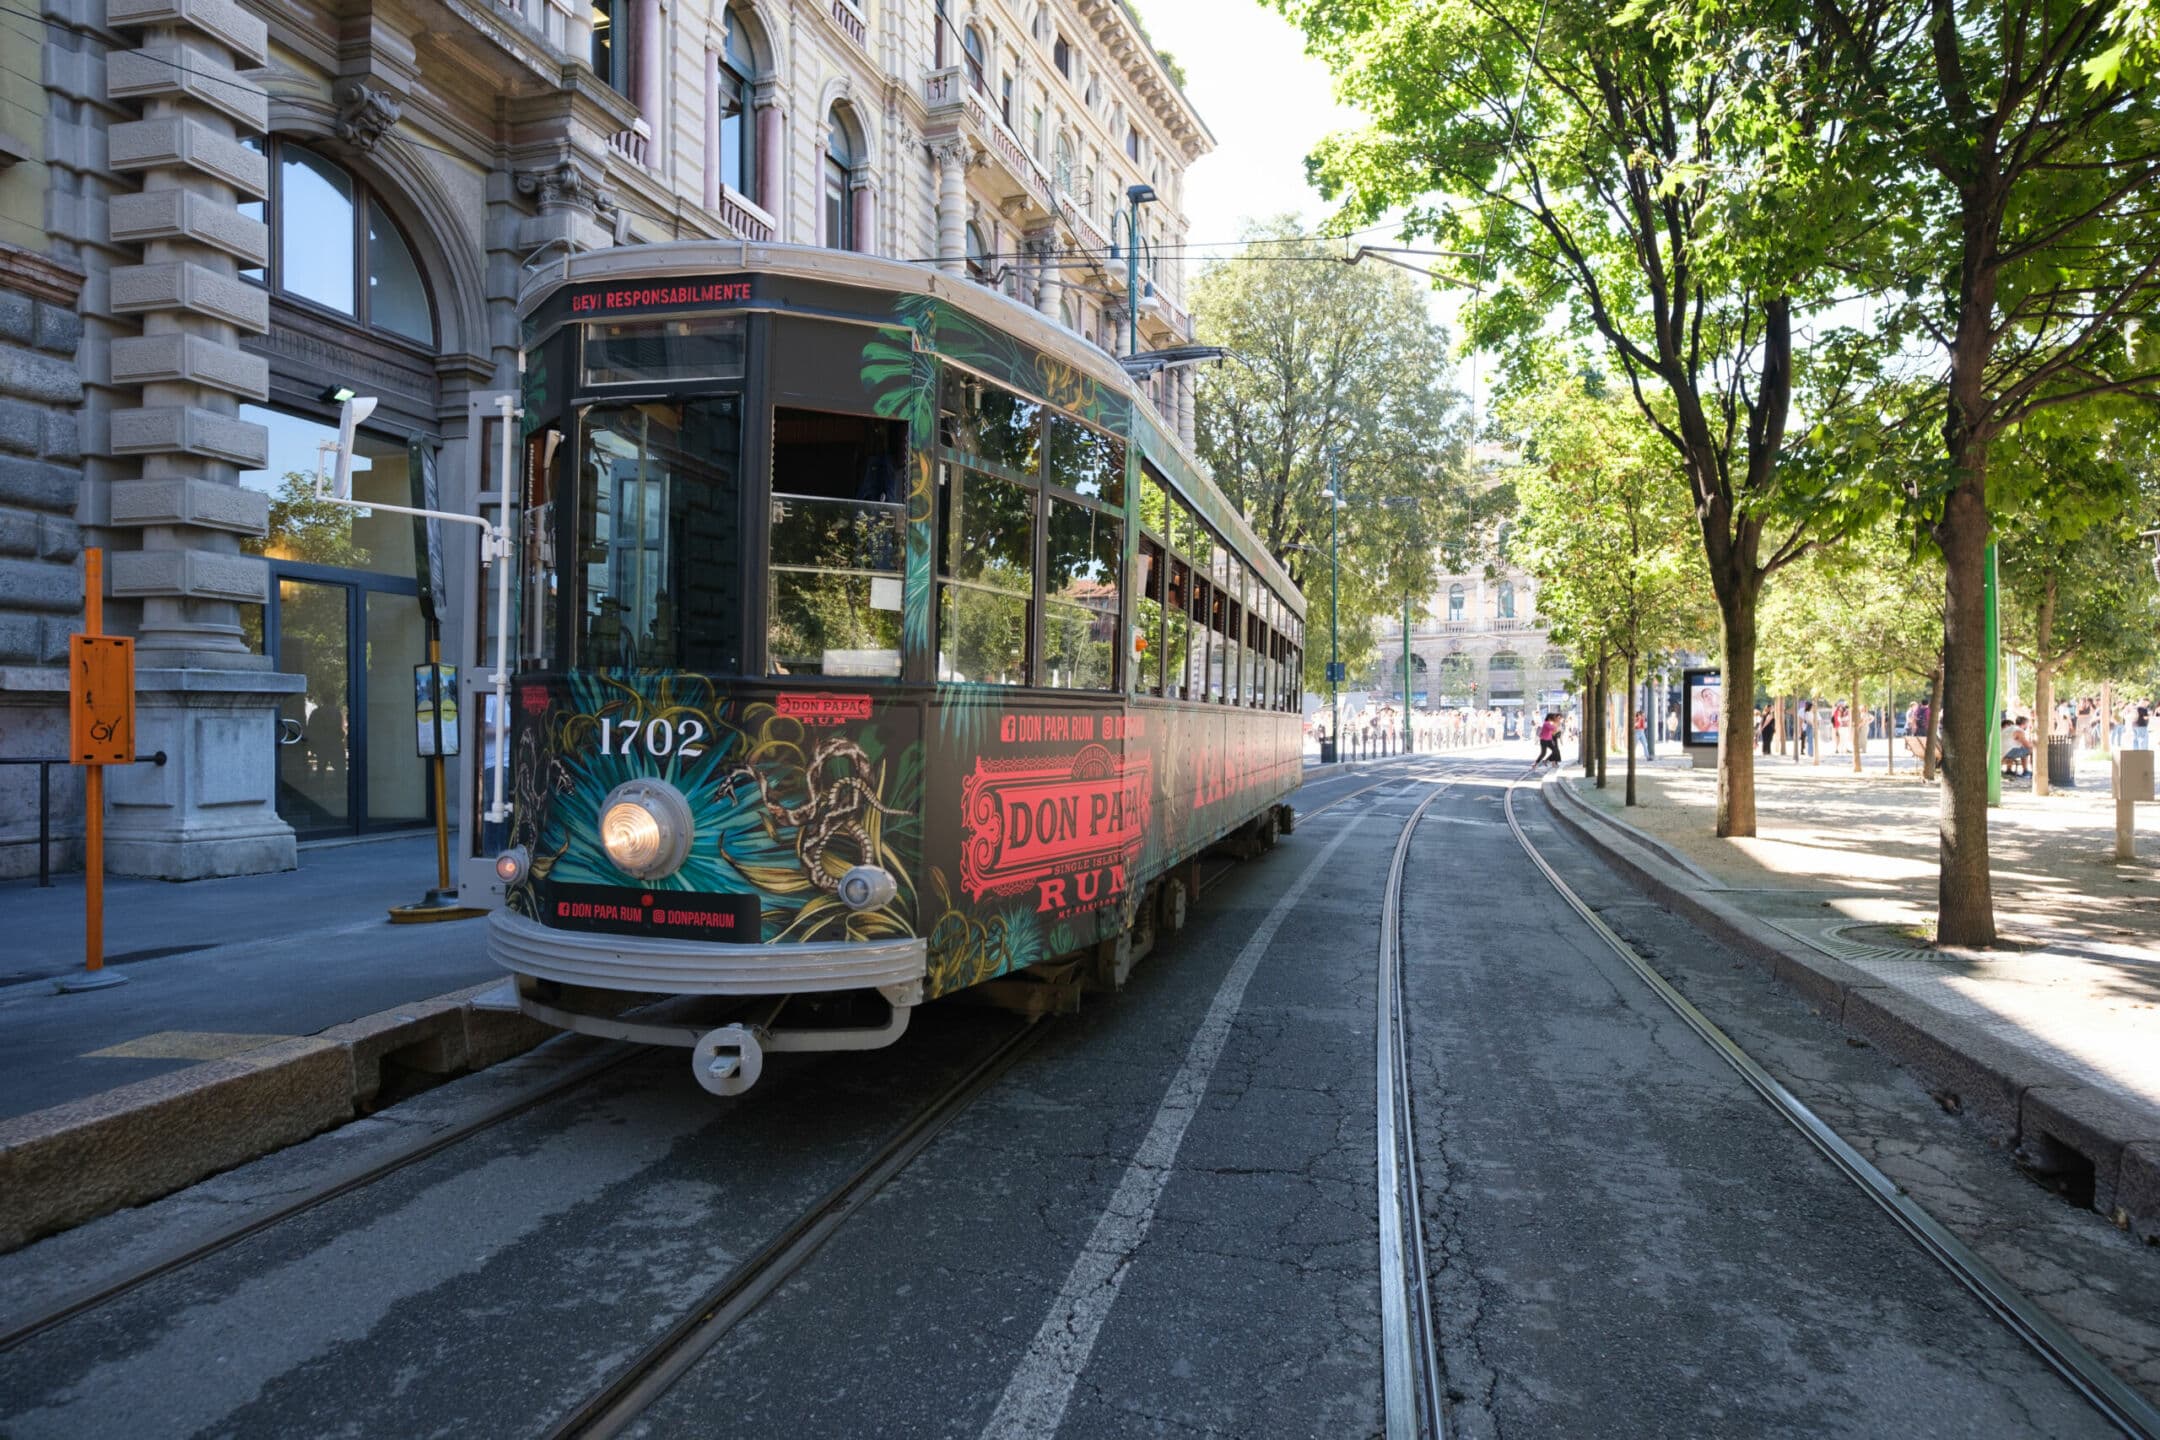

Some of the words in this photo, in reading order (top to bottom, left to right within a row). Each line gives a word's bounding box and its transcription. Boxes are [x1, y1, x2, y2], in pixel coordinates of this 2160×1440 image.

[573, 294, 601, 312] BEVI
[606, 283, 752, 309] RESPONSABILMENTE
[792, 701, 819, 711] DON
[823, 701, 857, 711] PAPA
[802, 716, 846, 726] RUM
[1019, 715, 1042, 742] DON
[1044, 715, 1070, 741] PAPA
[1072, 715, 1094, 741] RUM
[600, 718, 704, 757] 1702
[1008, 796, 1080, 850] DON
[1089, 786, 1139, 837] PAPA
[1054, 859, 1090, 876] SINGLE
[572, 903, 592, 917] DON
[594, 904, 618, 920] PAPA
[620, 907, 642, 922] RUM
[668, 910, 735, 928] DONPAPARUM
